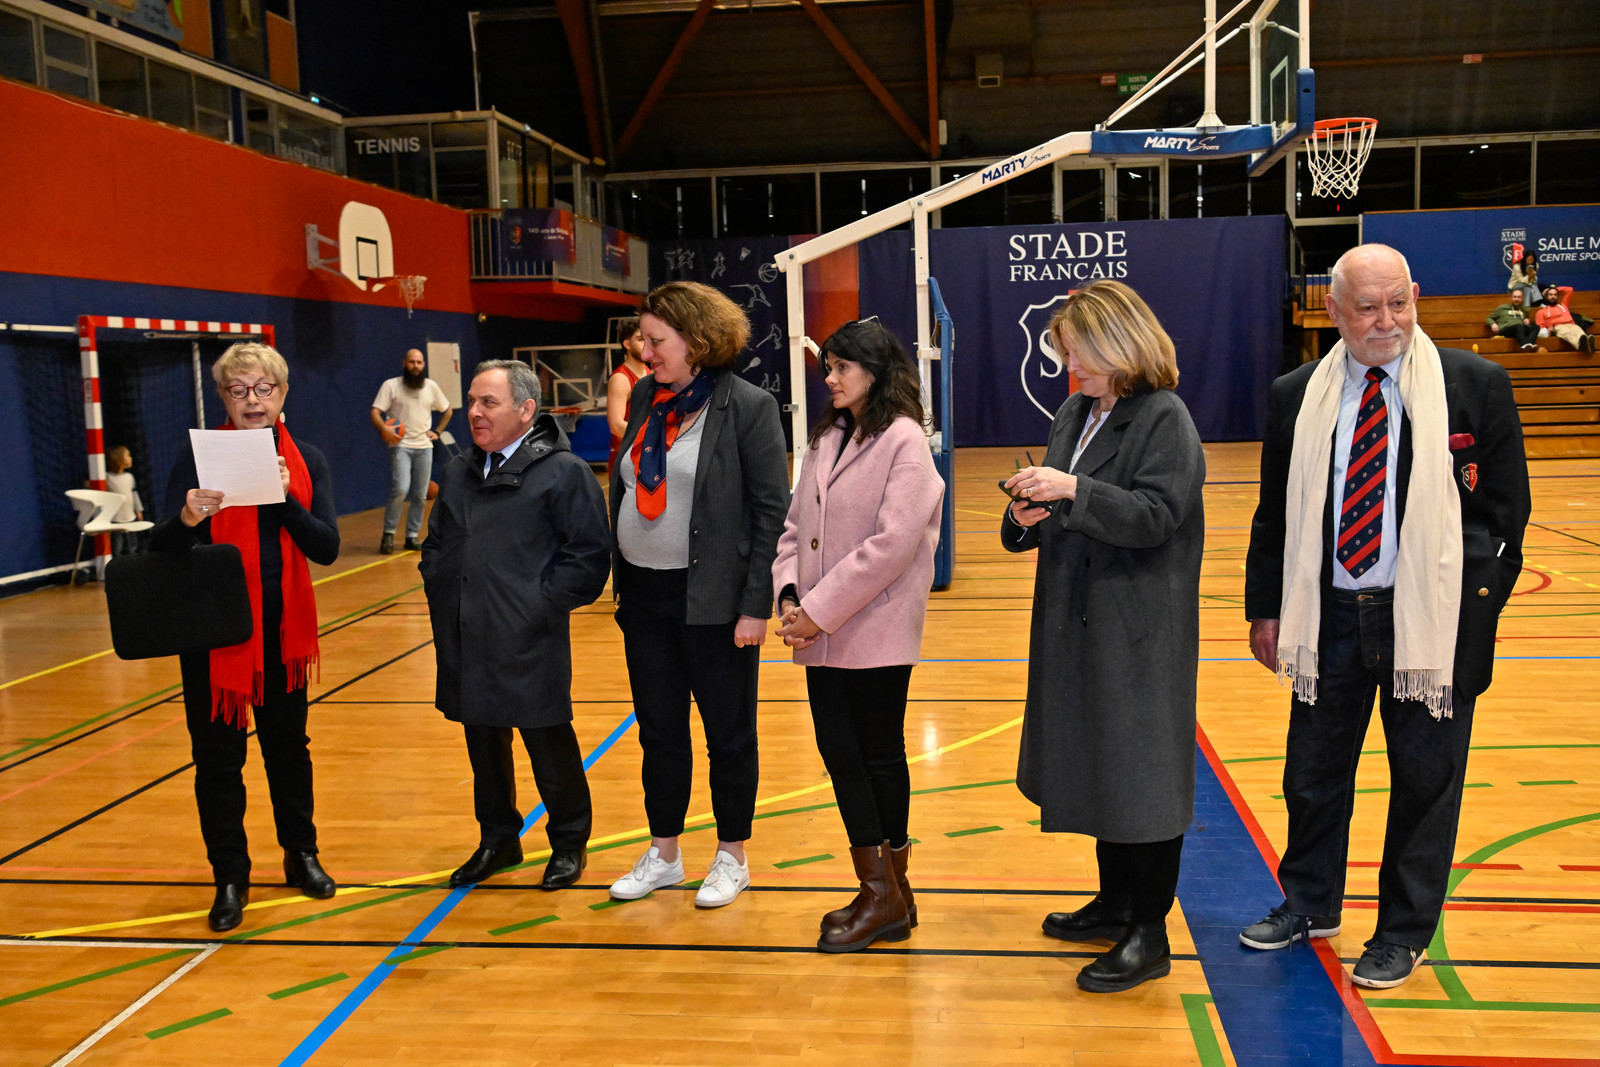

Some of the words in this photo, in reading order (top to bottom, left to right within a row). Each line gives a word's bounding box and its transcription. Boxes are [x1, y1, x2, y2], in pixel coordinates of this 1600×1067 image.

[354, 136, 421, 155] TENNIS
[1143, 136, 1197, 150] MARTY
[982, 155, 1027, 184] MARTY
[1008, 230, 1128, 261] STADE
[1538, 236, 1585, 251] SALLE
[1540, 252, 1577, 262] CENTRE
[1579, 251, 1600, 261] SPO
[1009, 260, 1128, 282] FRANÇAIS
